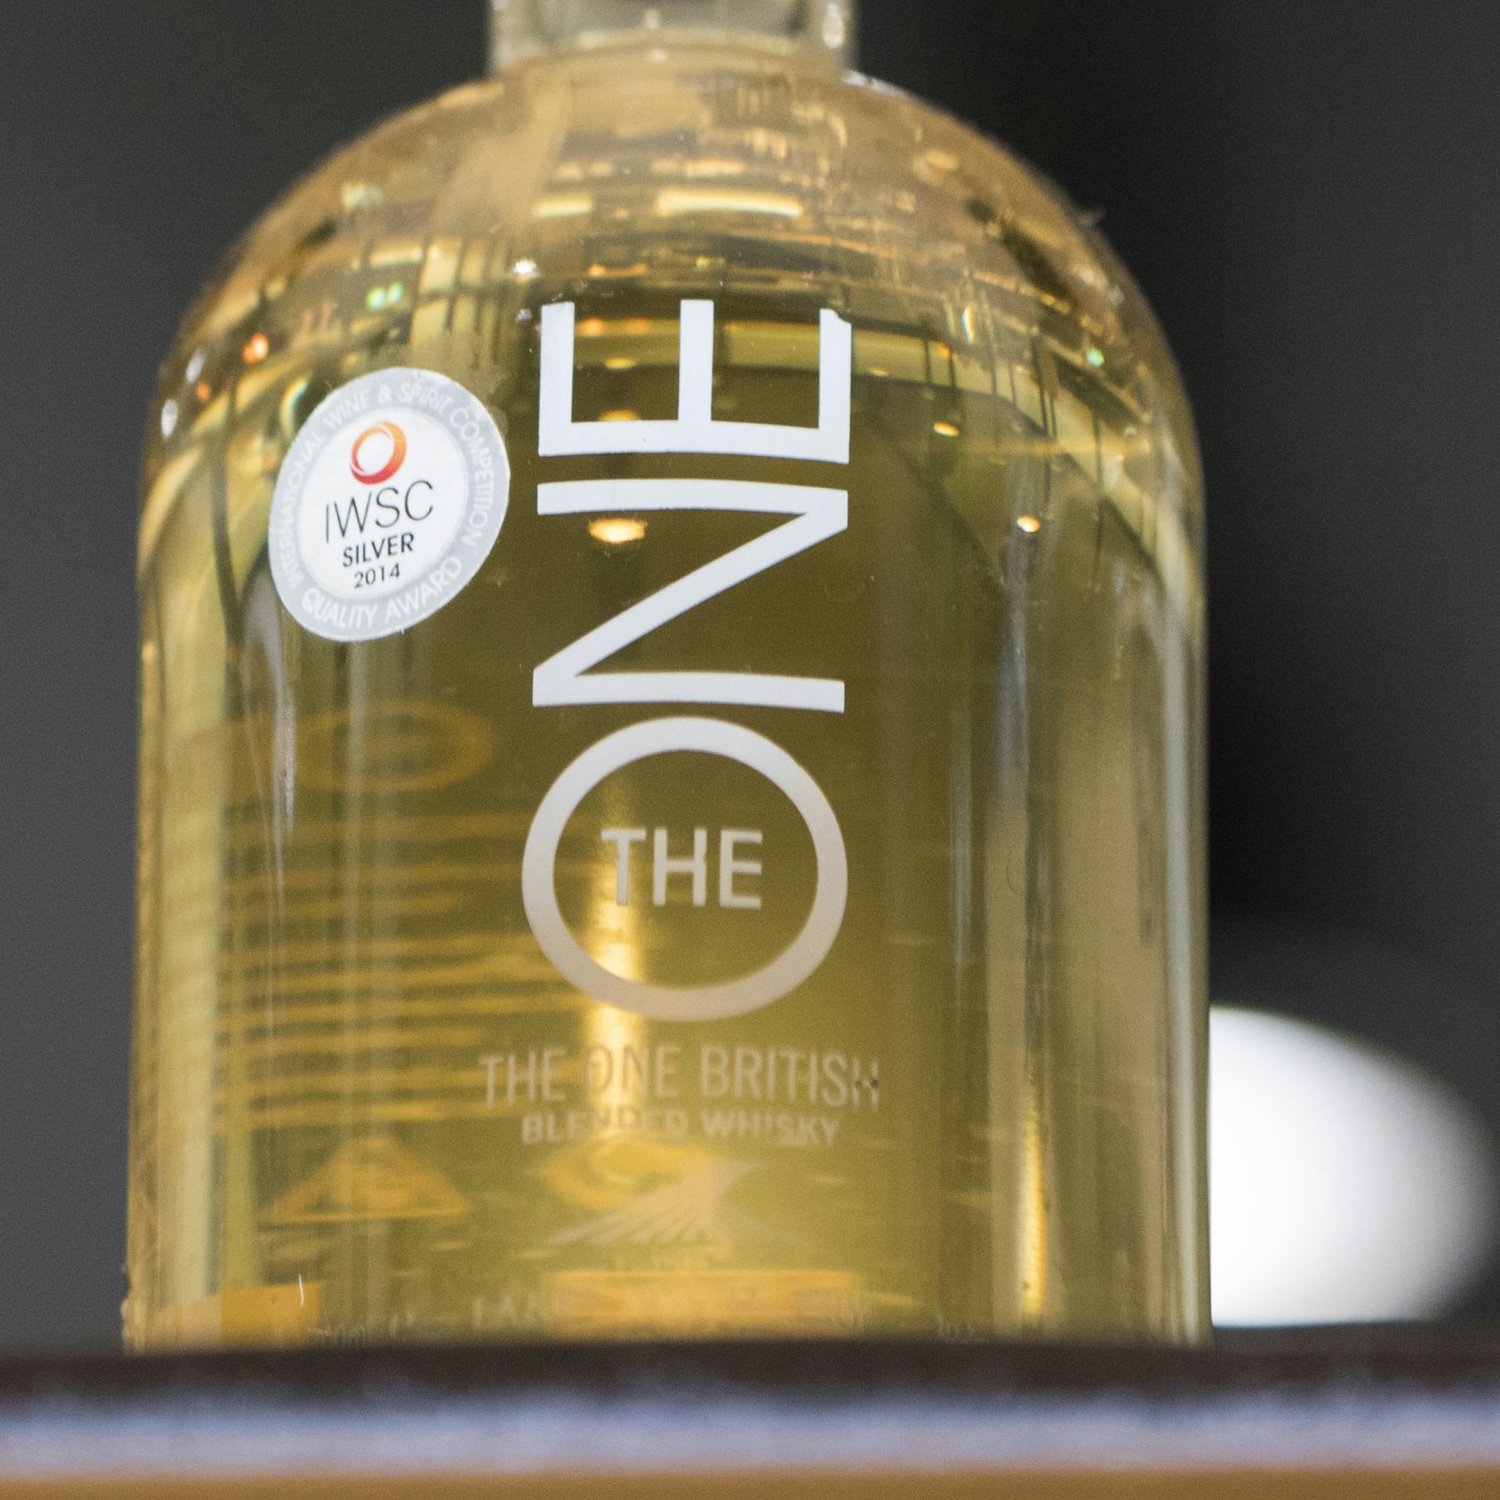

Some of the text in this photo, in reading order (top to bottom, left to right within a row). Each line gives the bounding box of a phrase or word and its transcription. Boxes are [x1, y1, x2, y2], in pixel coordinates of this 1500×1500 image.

[323, 389, 370, 431] WINE
[398, 382, 453, 412] SPIRIT
[450, 407, 493, 547] COMPETITION
[325, 479, 434, 543] IWSC
[342, 532, 415, 568] SILVER
[353, 562, 401, 589] 2014
[302, 556, 463, 630] QUALITY AWARD
[601, 828, 764, 910] THE
[477, 1043, 880, 1114] THE ONE BRITISH
[521, 1107, 840, 1147] BLENDED WHISKY
